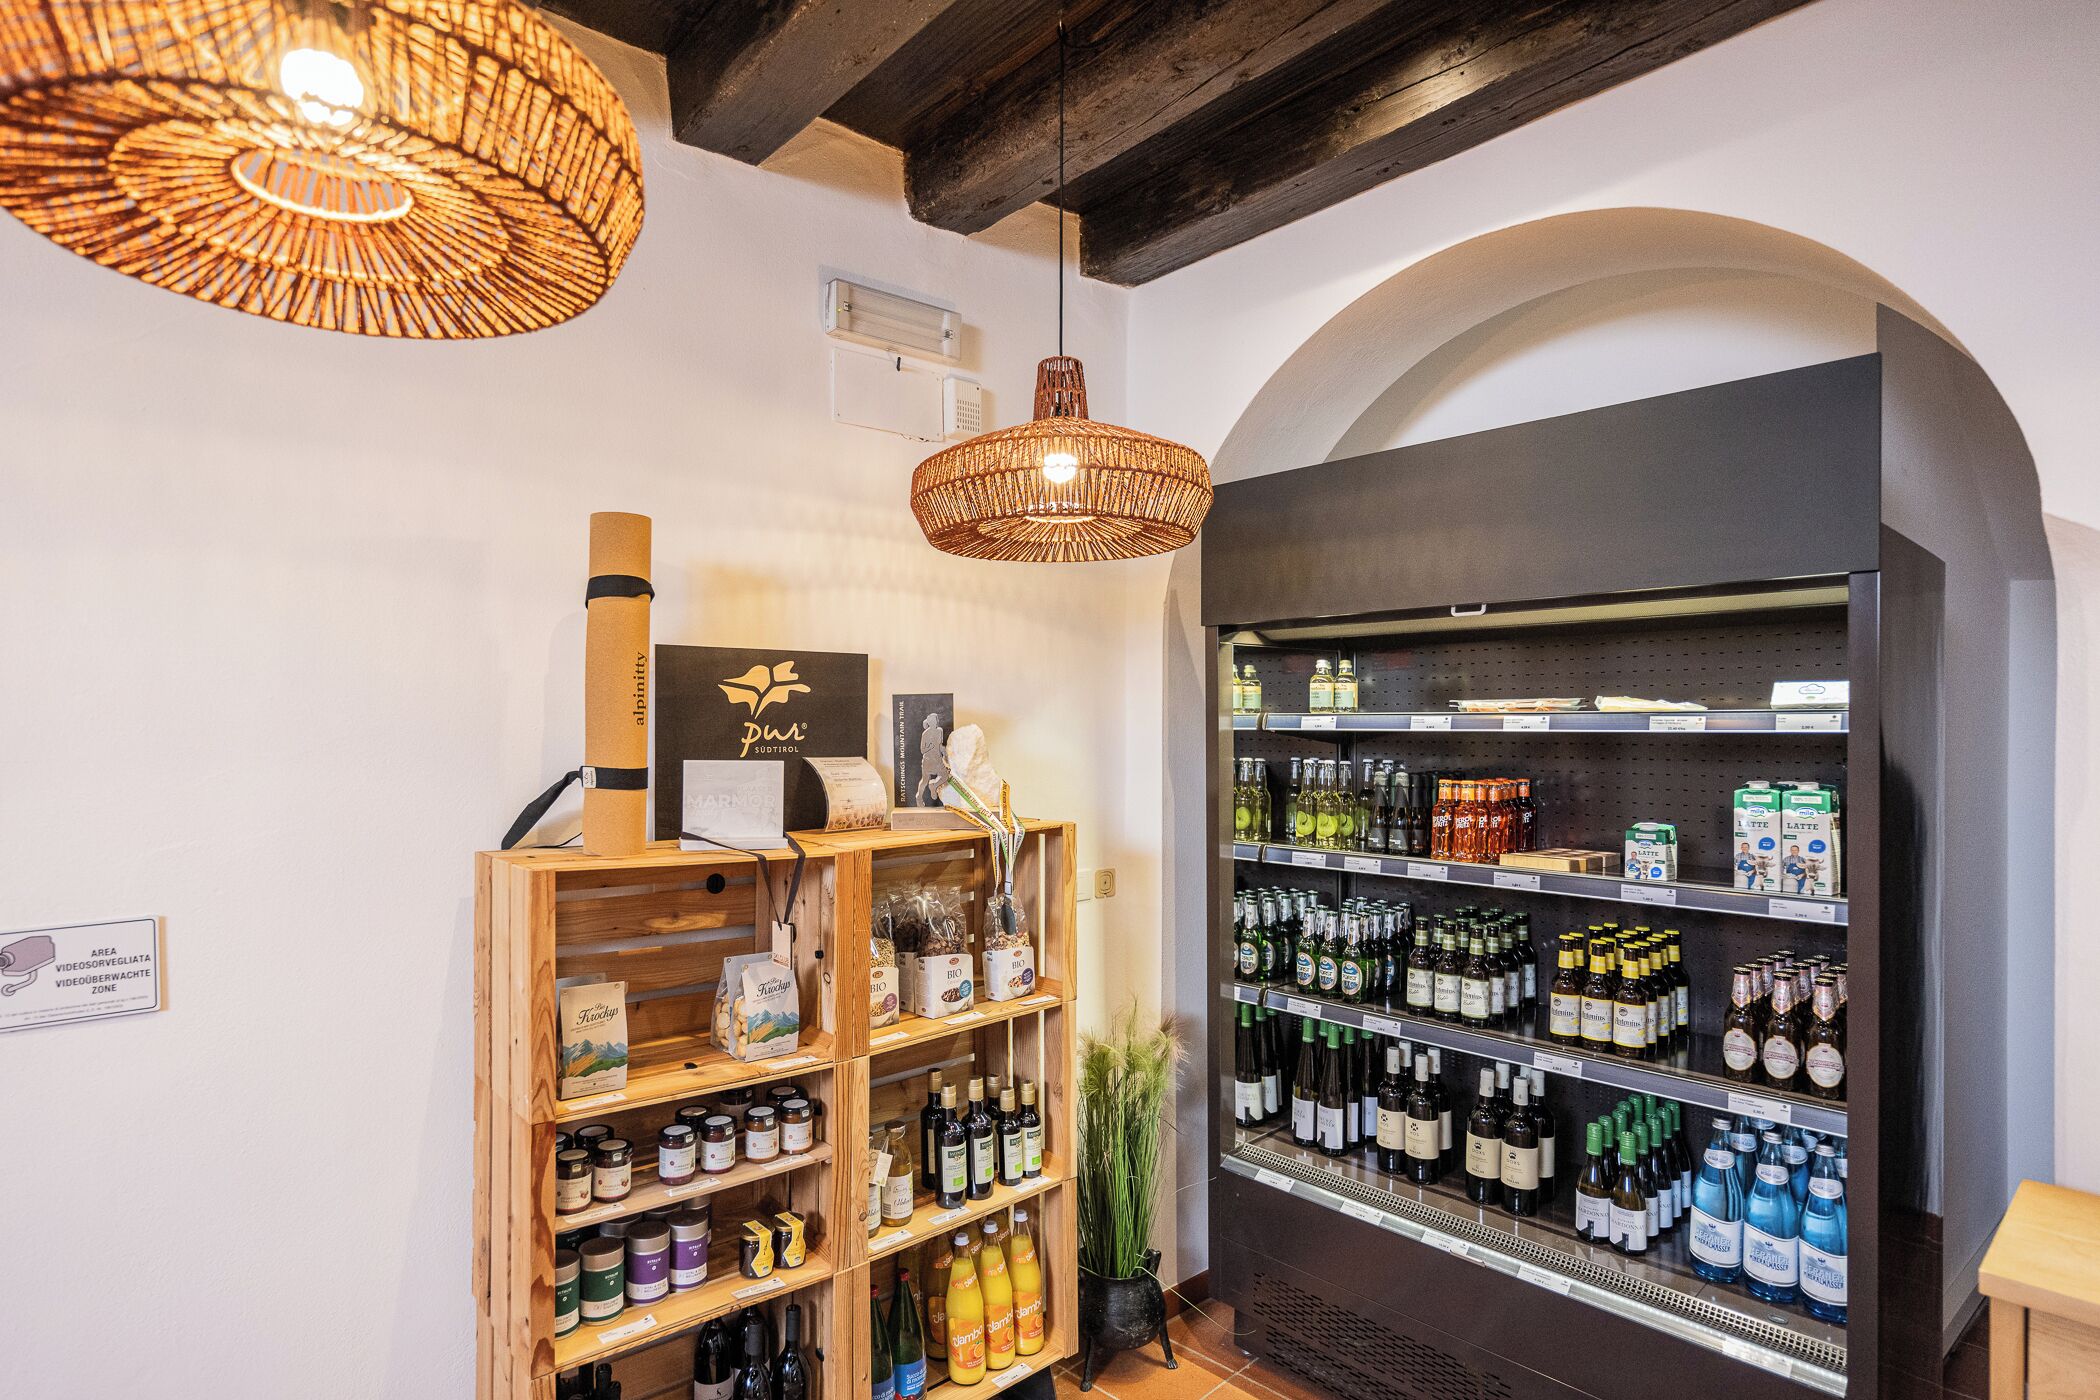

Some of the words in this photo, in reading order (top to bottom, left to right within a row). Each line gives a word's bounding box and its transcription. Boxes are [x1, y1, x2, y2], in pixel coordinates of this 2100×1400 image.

[632, 652, 648, 726] alpinitty
[898, 721, 906, 759] MOUNTAIN
[754, 745, 800, 755] SÜDTIROL
[899, 761, 907, 803] RATSCHINGS
[686, 793, 776, 809] MARMOR
[1786, 822, 1819, 831] LATTE
[90, 947, 118, 958] AREA
[55, 953, 152, 973] VIDEOSORVEGLIATA
[1011, 959, 1025, 970] BIO
[55, 968, 152, 988] VIDEOÜBERWACHTE
[947, 968, 963, 980] BIO
[91, 983, 118, 995] ZONE
[870, 981, 887, 994] BIO
[952, 1324, 984, 1348] Jambo
